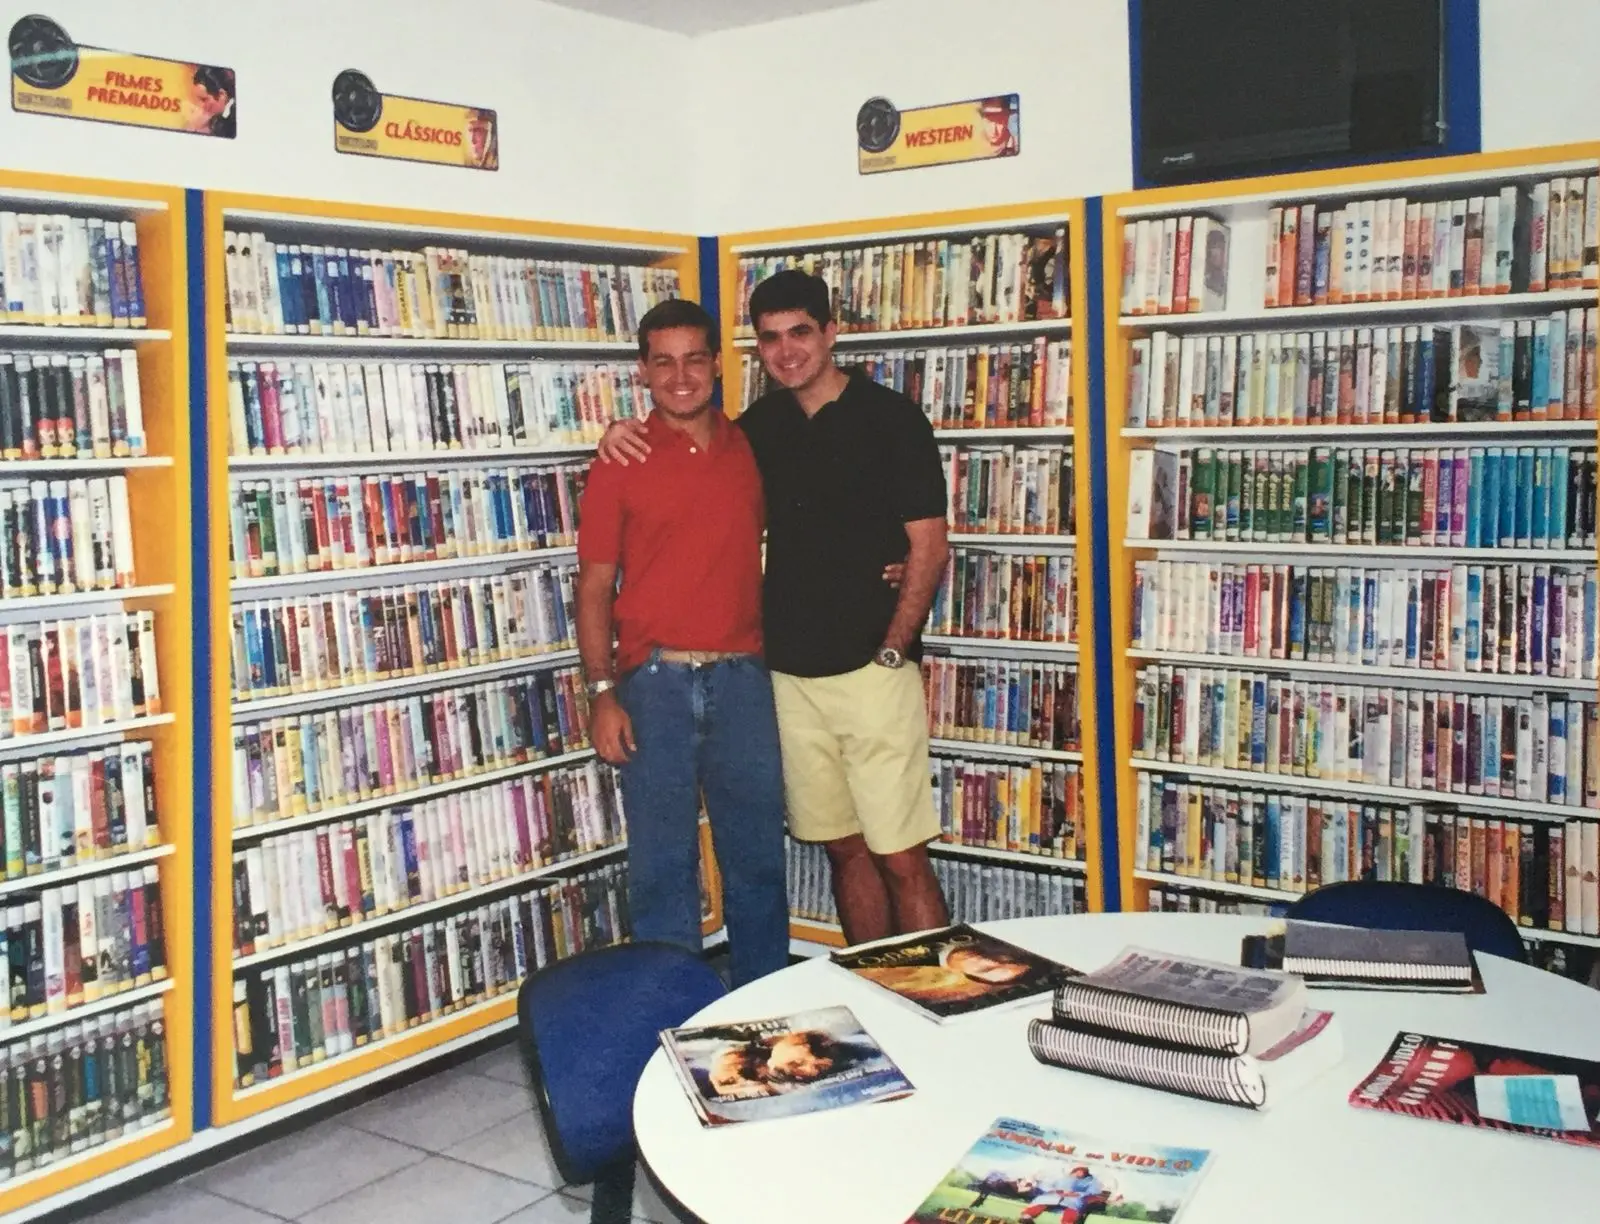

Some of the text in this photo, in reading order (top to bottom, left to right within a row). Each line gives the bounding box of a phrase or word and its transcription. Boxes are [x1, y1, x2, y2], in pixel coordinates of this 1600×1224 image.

[105, 70, 164, 93] FILMES
[87, 85, 182, 113] PREMIADOS
[384, 119, 463, 146] CLÁSSICOS
[904, 124, 974, 149] WESTERN
